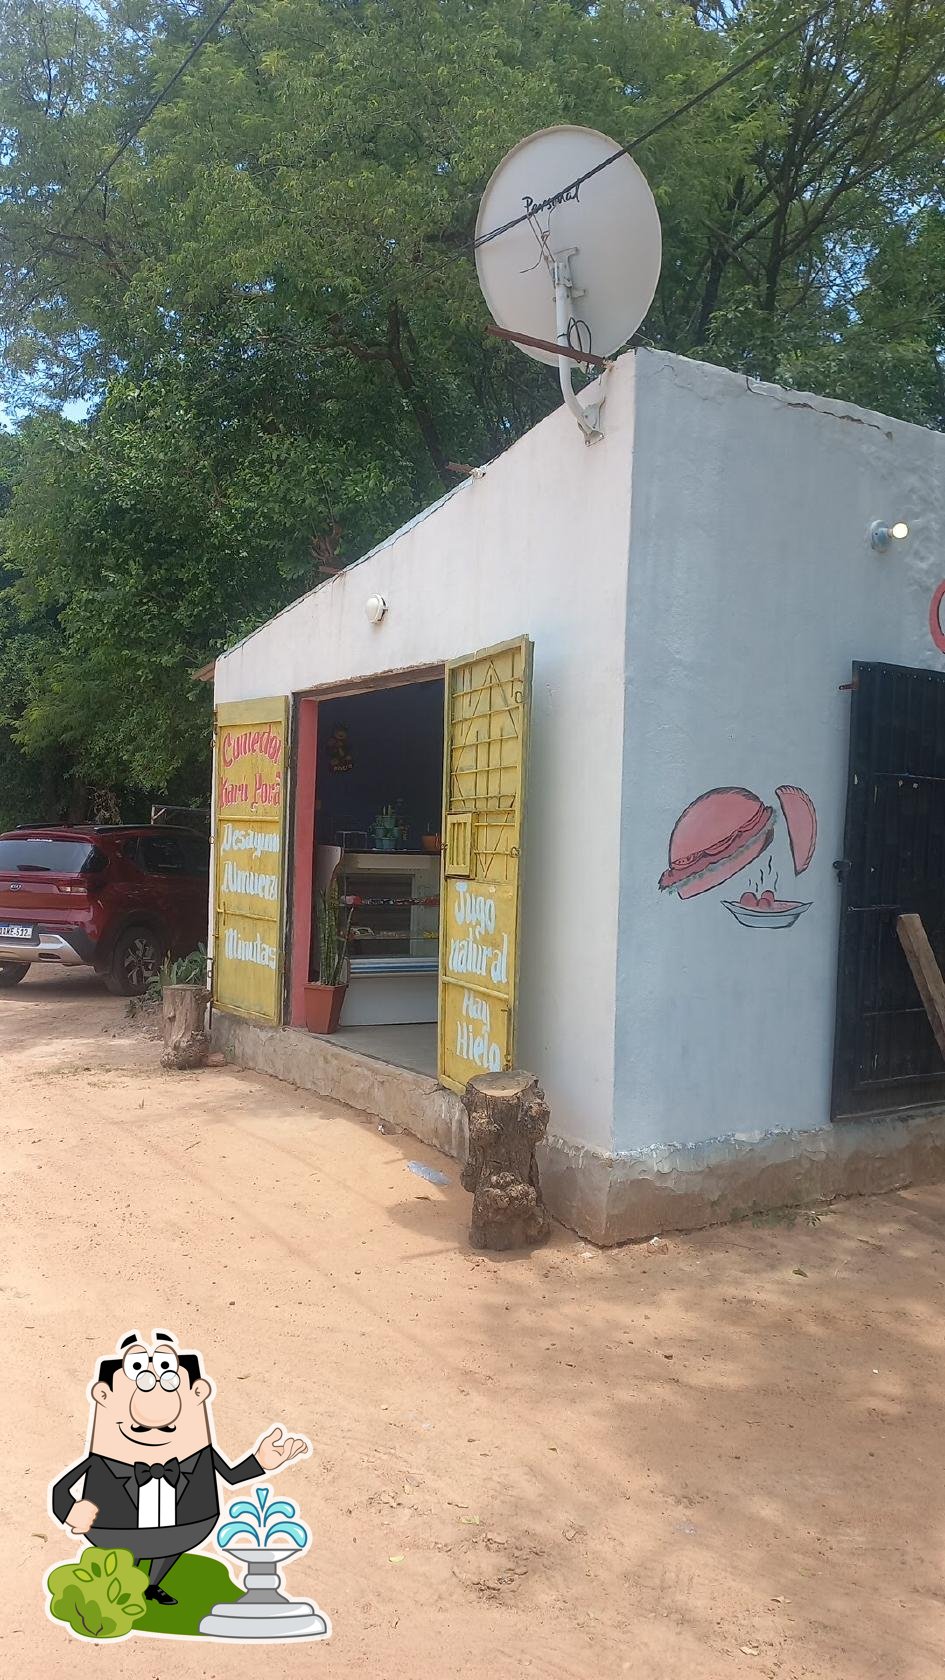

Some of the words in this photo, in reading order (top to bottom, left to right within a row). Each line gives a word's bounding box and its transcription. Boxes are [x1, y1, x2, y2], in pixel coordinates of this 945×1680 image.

[455, 882, 496, 938] Jugo
[224, 927, 277, 970] Minutas
[463, 988, 490, 1032] Hay
[456, 1020, 501, 1073] Hielo
